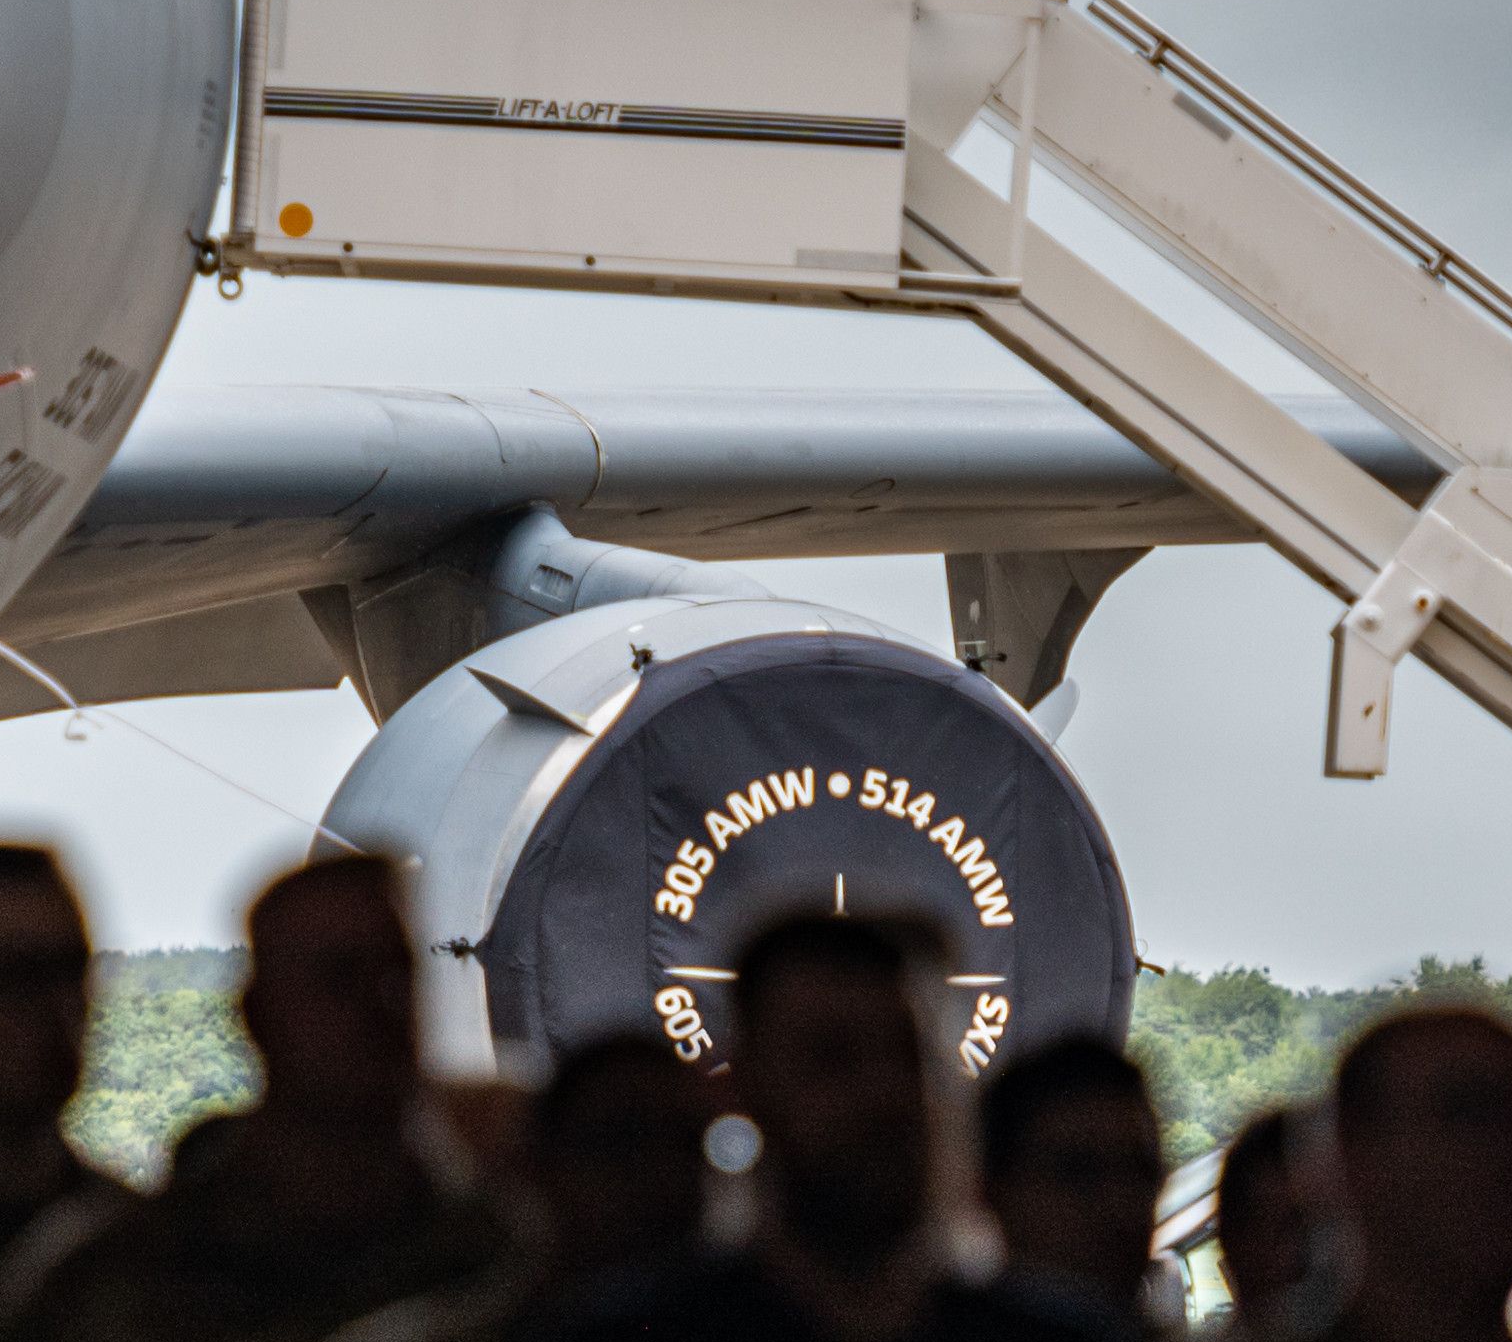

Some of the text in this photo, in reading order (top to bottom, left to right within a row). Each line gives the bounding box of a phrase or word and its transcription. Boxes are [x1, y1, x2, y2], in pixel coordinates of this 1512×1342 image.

[497, 98, 619, 122] LIFT-A-LOFT
[655, 766, 1014, 927] 305 AMW 514 AMW
[655, 985, 714, 1061] 605
